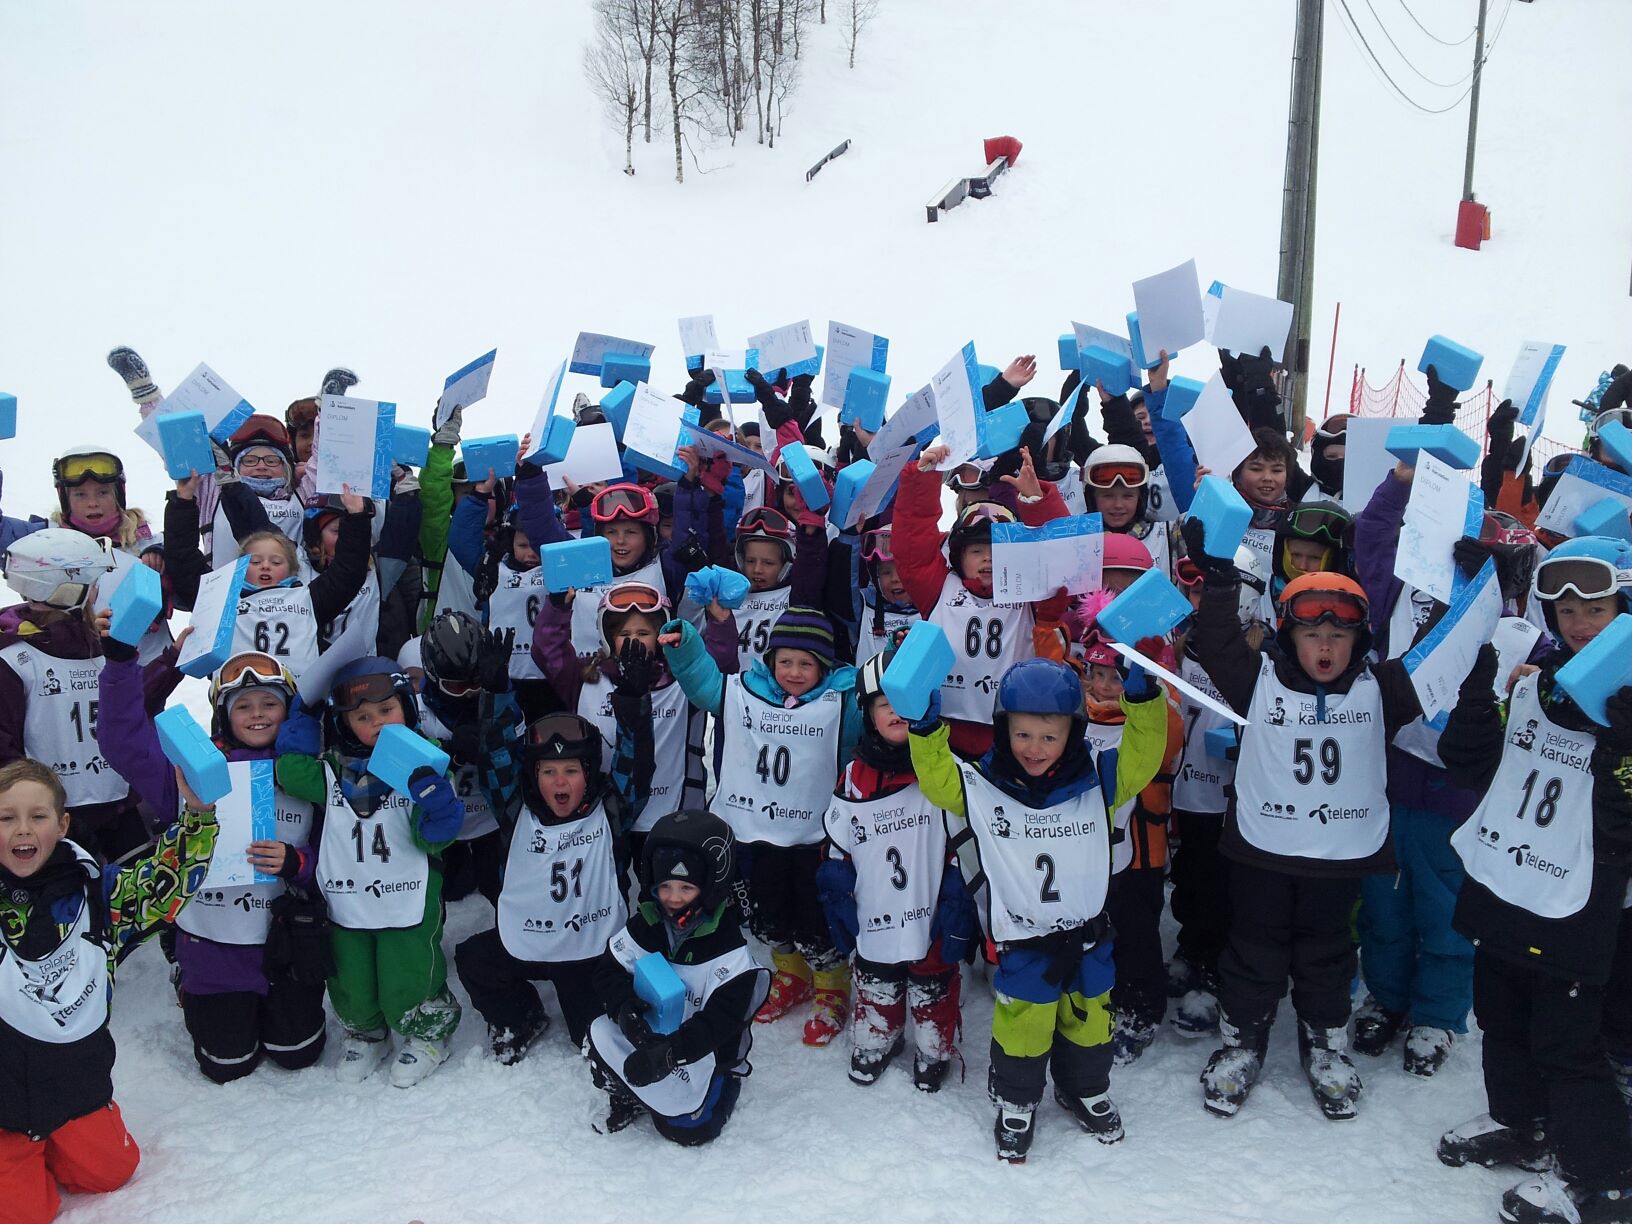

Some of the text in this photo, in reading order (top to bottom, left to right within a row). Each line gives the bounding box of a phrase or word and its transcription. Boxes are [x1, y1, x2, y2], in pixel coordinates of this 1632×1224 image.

[1242, 536, 1272, 554] arusel
[255, 621, 290, 656] 62
[738, 619, 770, 654] 45
[965, 616, 1003, 659] 68
[69, 669, 98, 679] telenor
[71, 680, 99, 690] karus
[652, 708, 676, 719] ellen
[762, 711, 793, 722] telenor
[760, 721, 824, 738] karusellen
[1546, 732, 1585, 752] telenor
[756, 744, 791, 787] 40
[1293, 737, 1341, 786] 59
[1540, 743, 1591, 774] karusell
[650, 785, 669, 796] enor
[1516, 768, 1563, 828] 18
[377, 795, 410, 811] sellen
[776, 806, 813, 820] telenor
[873, 806, 905, 822] telenor
[1024, 812, 1062, 825] telenor
[1328, 807, 1370, 820] telenor
[874, 813, 930, 836] karuselen
[1025, 821, 1096, 839] karusellen
[351, 820, 391, 863] 14
[886, 845, 908, 891] 3
[1525, 851, 1570, 880] telenor
[380, 880, 422, 894] telenor
[550, 858, 584, 903] 51
[1035, 853, 1061, 903] 2
[251, 898, 272, 909] tele
[579, 906, 612, 926] telenor
[904, 906, 930, 922] teleno
[39, 948, 76, 975] telenor
[58, 978, 98, 1019] telenor
